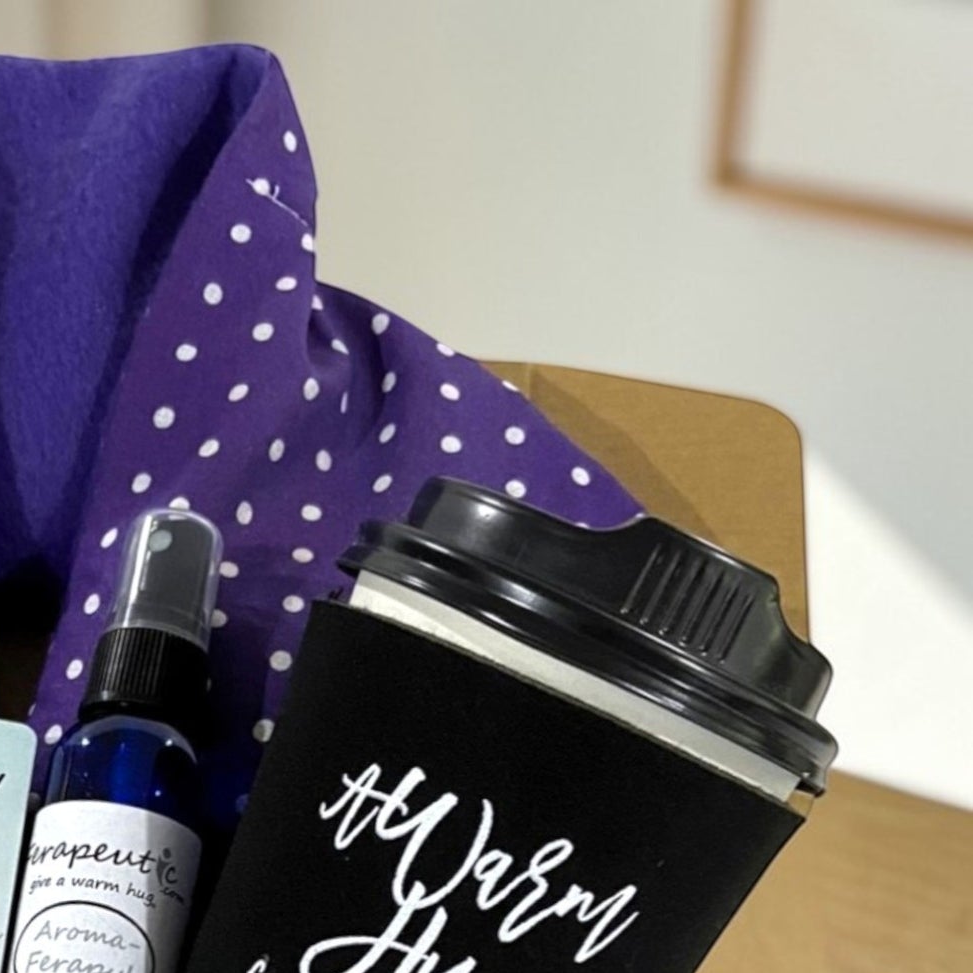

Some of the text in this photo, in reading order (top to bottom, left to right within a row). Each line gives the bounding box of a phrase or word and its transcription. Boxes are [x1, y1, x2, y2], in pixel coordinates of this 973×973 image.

[28, 840, 178, 884] erapeutic
[375, 766, 639, 963] Warm
[29, 874, 52, 894] give
[55, 876, 66, 887] a
[71, 875, 120, 893] warm
[34, 920, 141, 950] Aroma-
